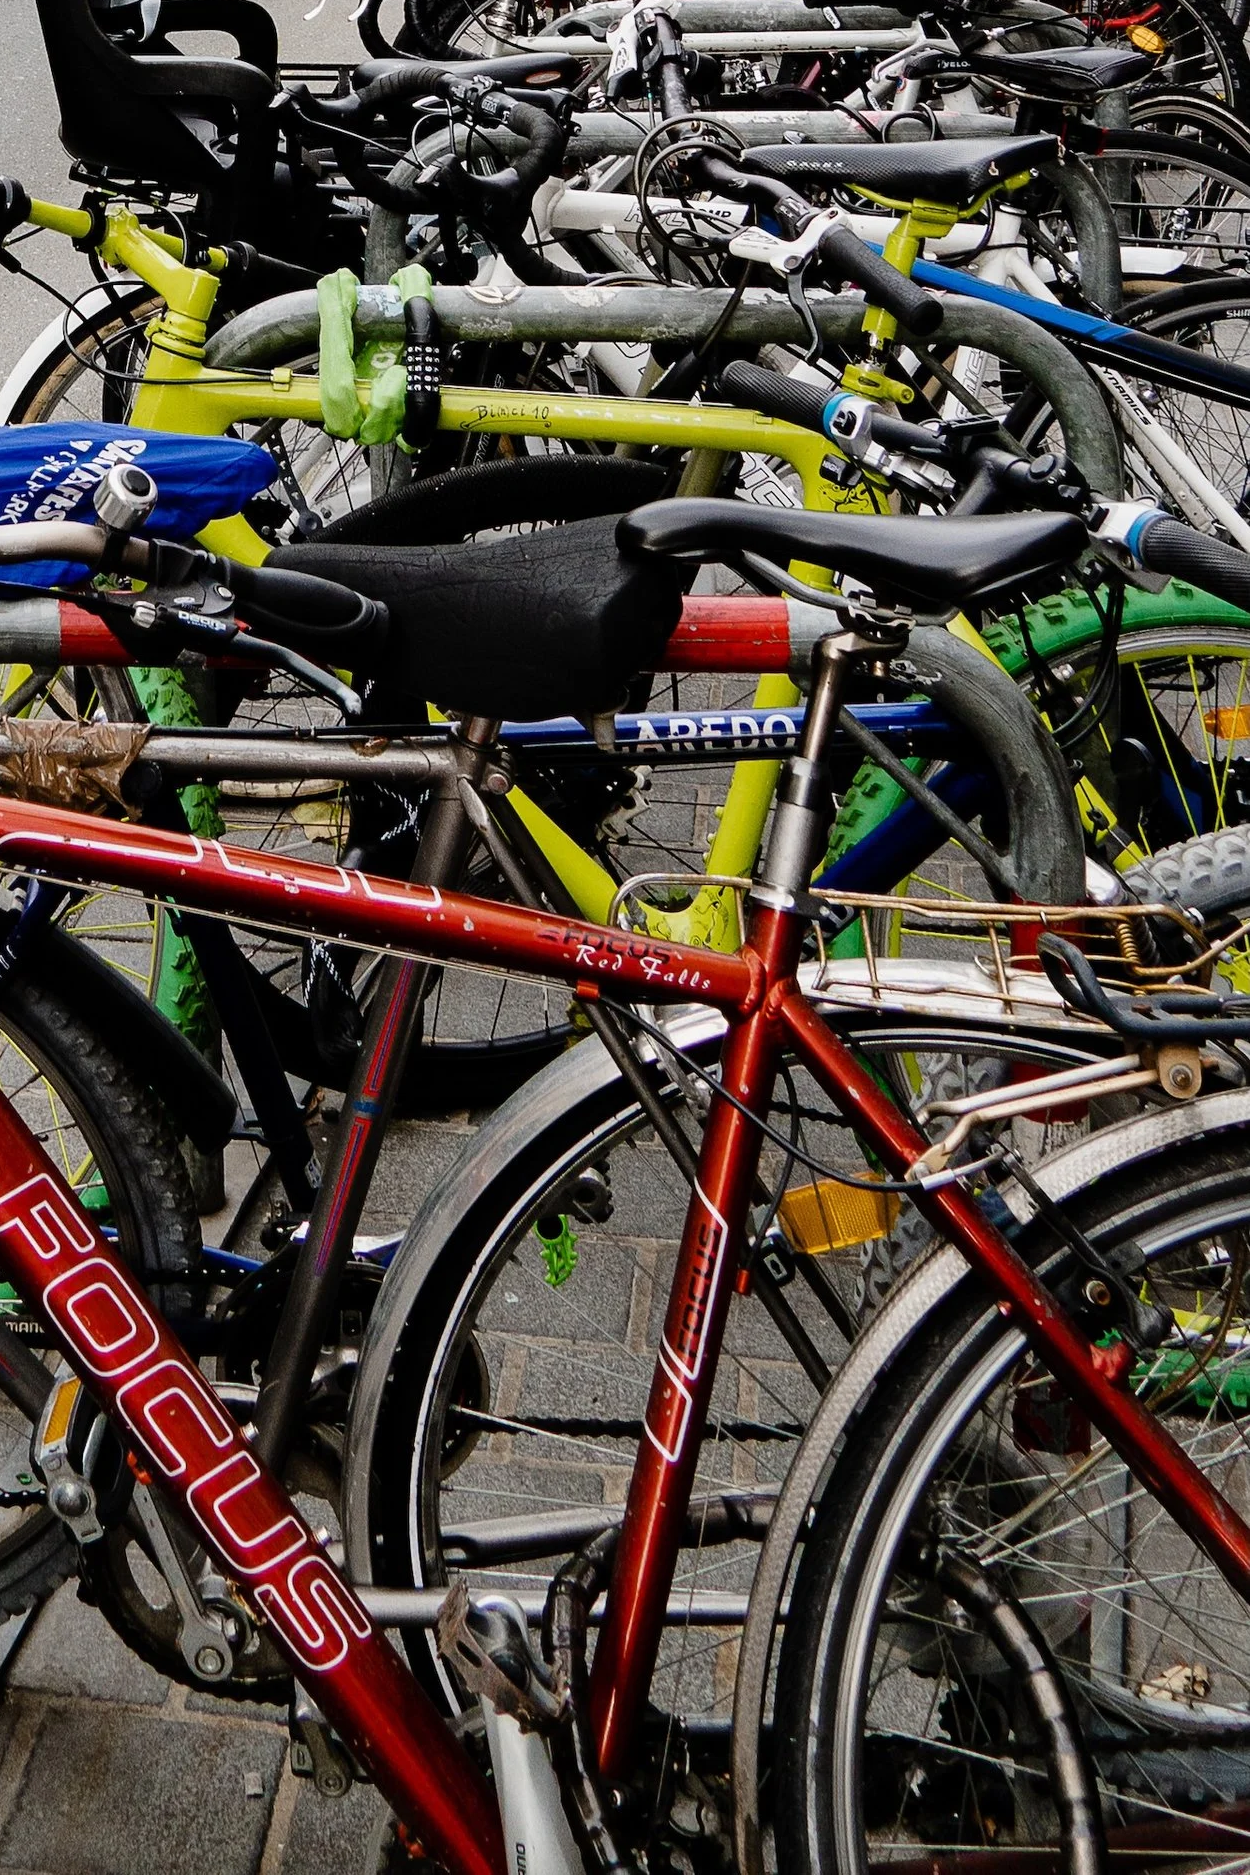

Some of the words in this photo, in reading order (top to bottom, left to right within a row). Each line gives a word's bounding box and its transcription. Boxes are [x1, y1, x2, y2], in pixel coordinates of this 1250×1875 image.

[622, 714, 797, 754] AREDO
[575, 944, 623, 971] Red
[639, 956, 711, 990] Falls
[677, 1222, 722, 1359] FOCUS
